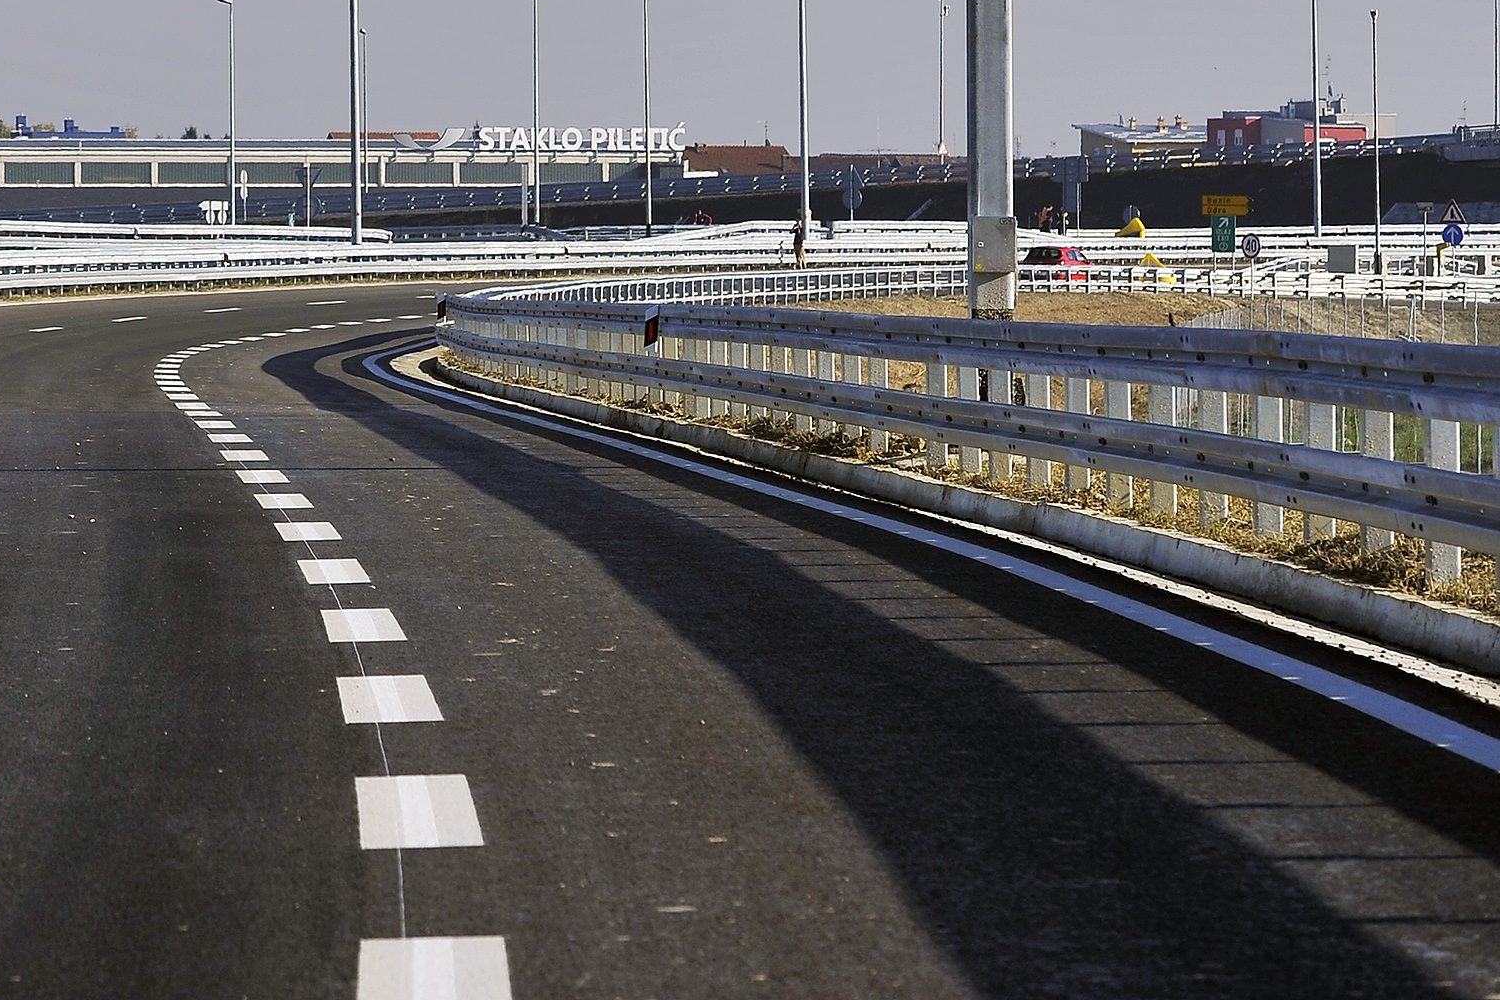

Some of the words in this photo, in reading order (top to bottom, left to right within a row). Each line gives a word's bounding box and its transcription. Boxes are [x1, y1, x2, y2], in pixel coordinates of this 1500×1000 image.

[478, 126, 583, 151] STAKLO
[590, 121, 686, 151] PILETIĆ
[1244, 238, 1257, 253] 40
